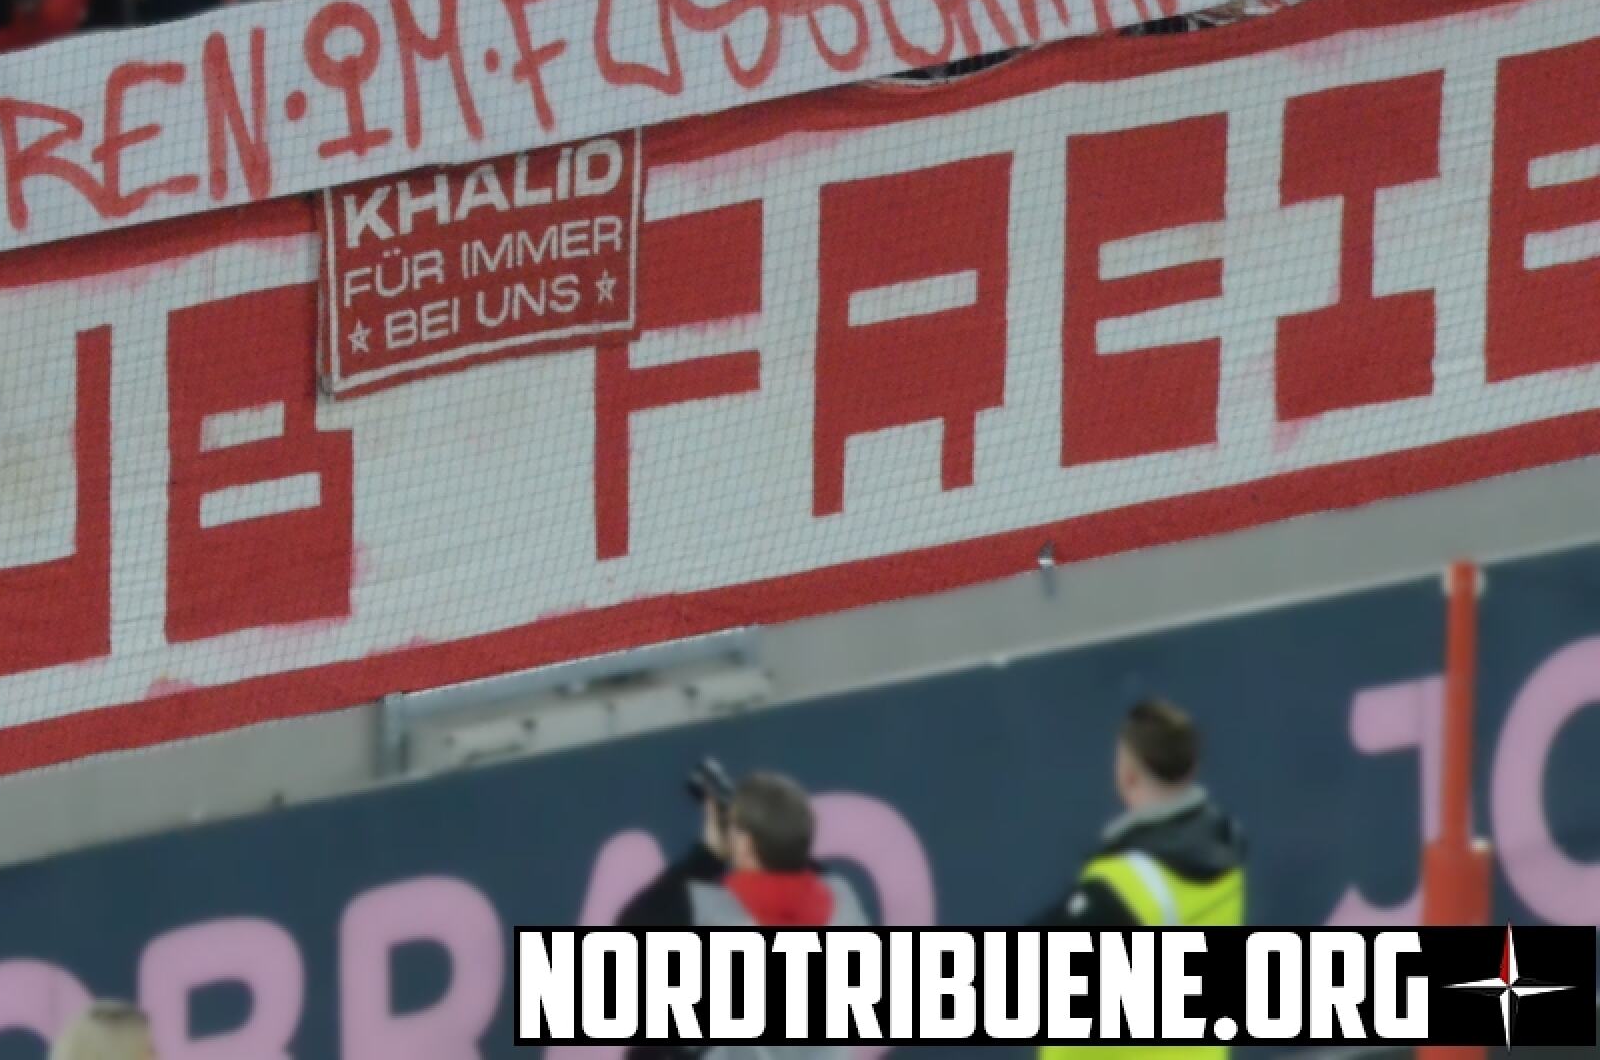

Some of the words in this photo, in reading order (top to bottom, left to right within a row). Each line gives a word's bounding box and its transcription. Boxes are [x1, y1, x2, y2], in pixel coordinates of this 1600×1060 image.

[343, 139, 624, 249] KHALID
[343, 248, 445, 308] FÜR
[461, 215, 624, 280] IMMER
[384, 298, 461, 350] BEI
[476, 273, 582, 328] UNS
